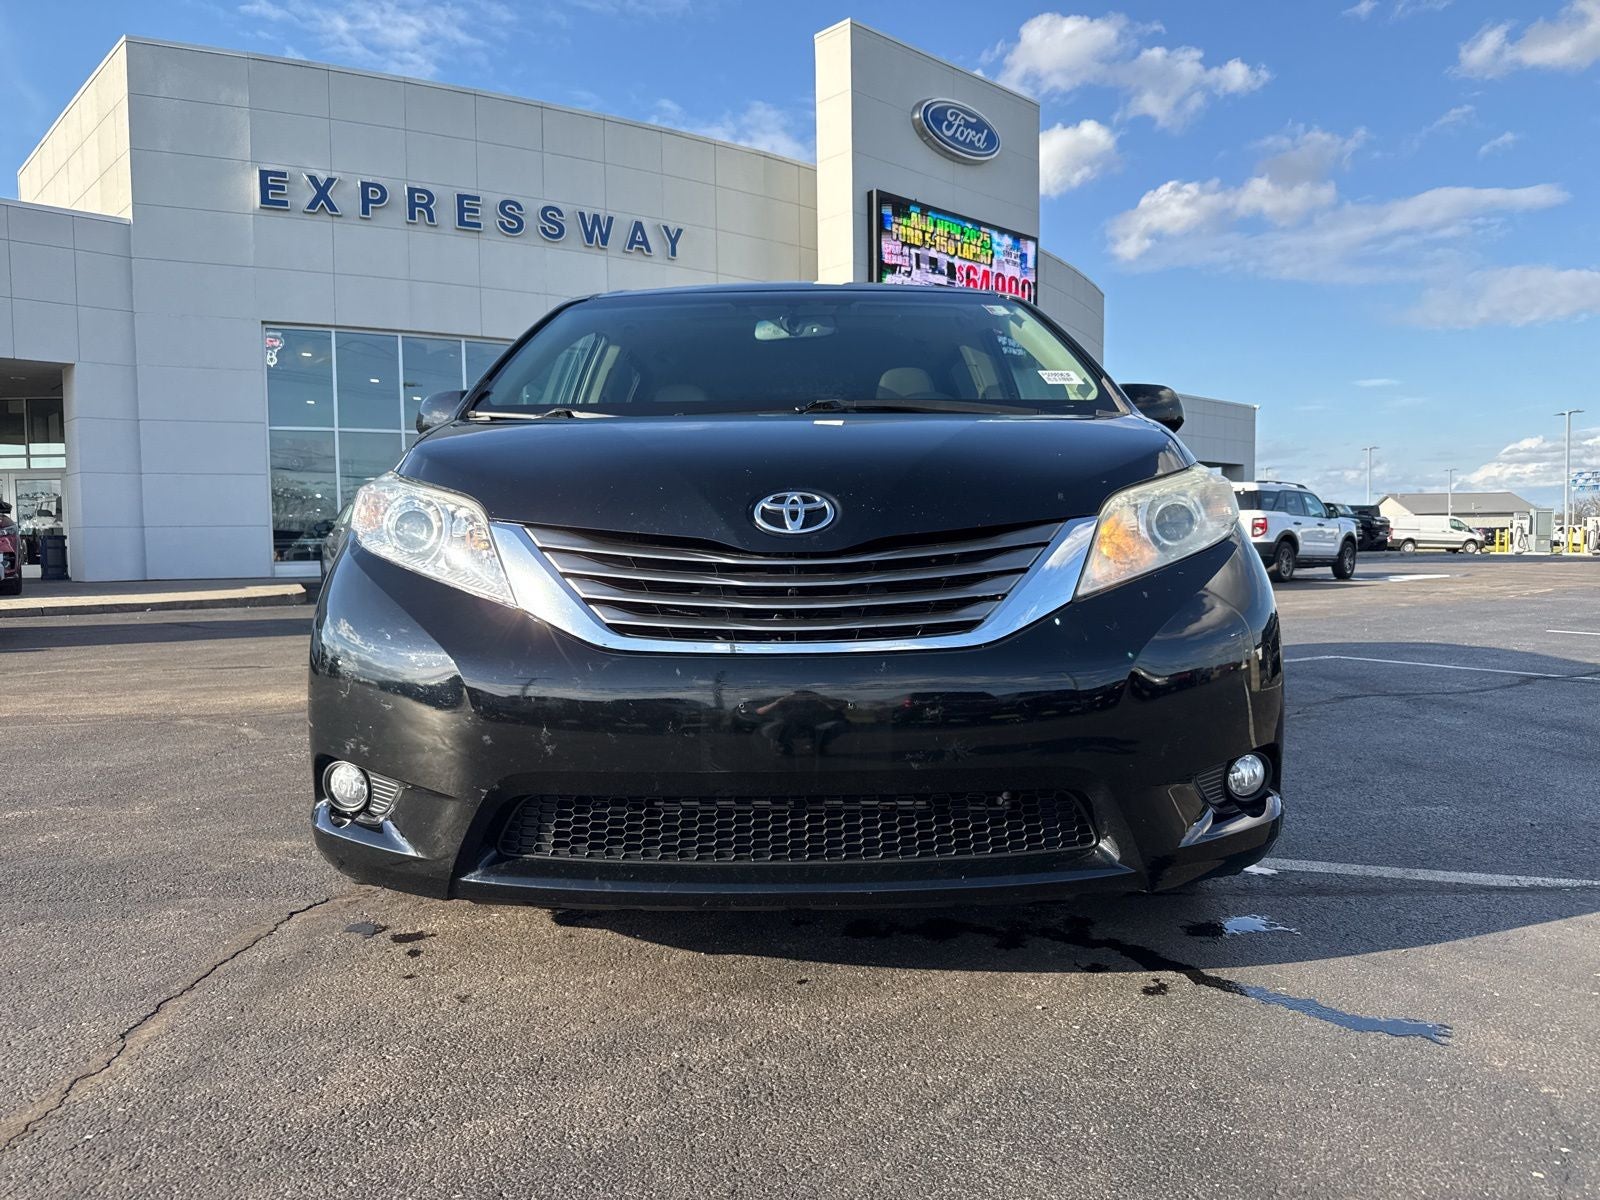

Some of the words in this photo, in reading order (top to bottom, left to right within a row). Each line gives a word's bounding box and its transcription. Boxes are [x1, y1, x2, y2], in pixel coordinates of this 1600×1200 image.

[942, 109, 988, 149] Ford
[257, 166, 684, 260] EXPRESSWAY
[891, 223, 923, 246] FORD
[963, 227, 991, 249] 2025
